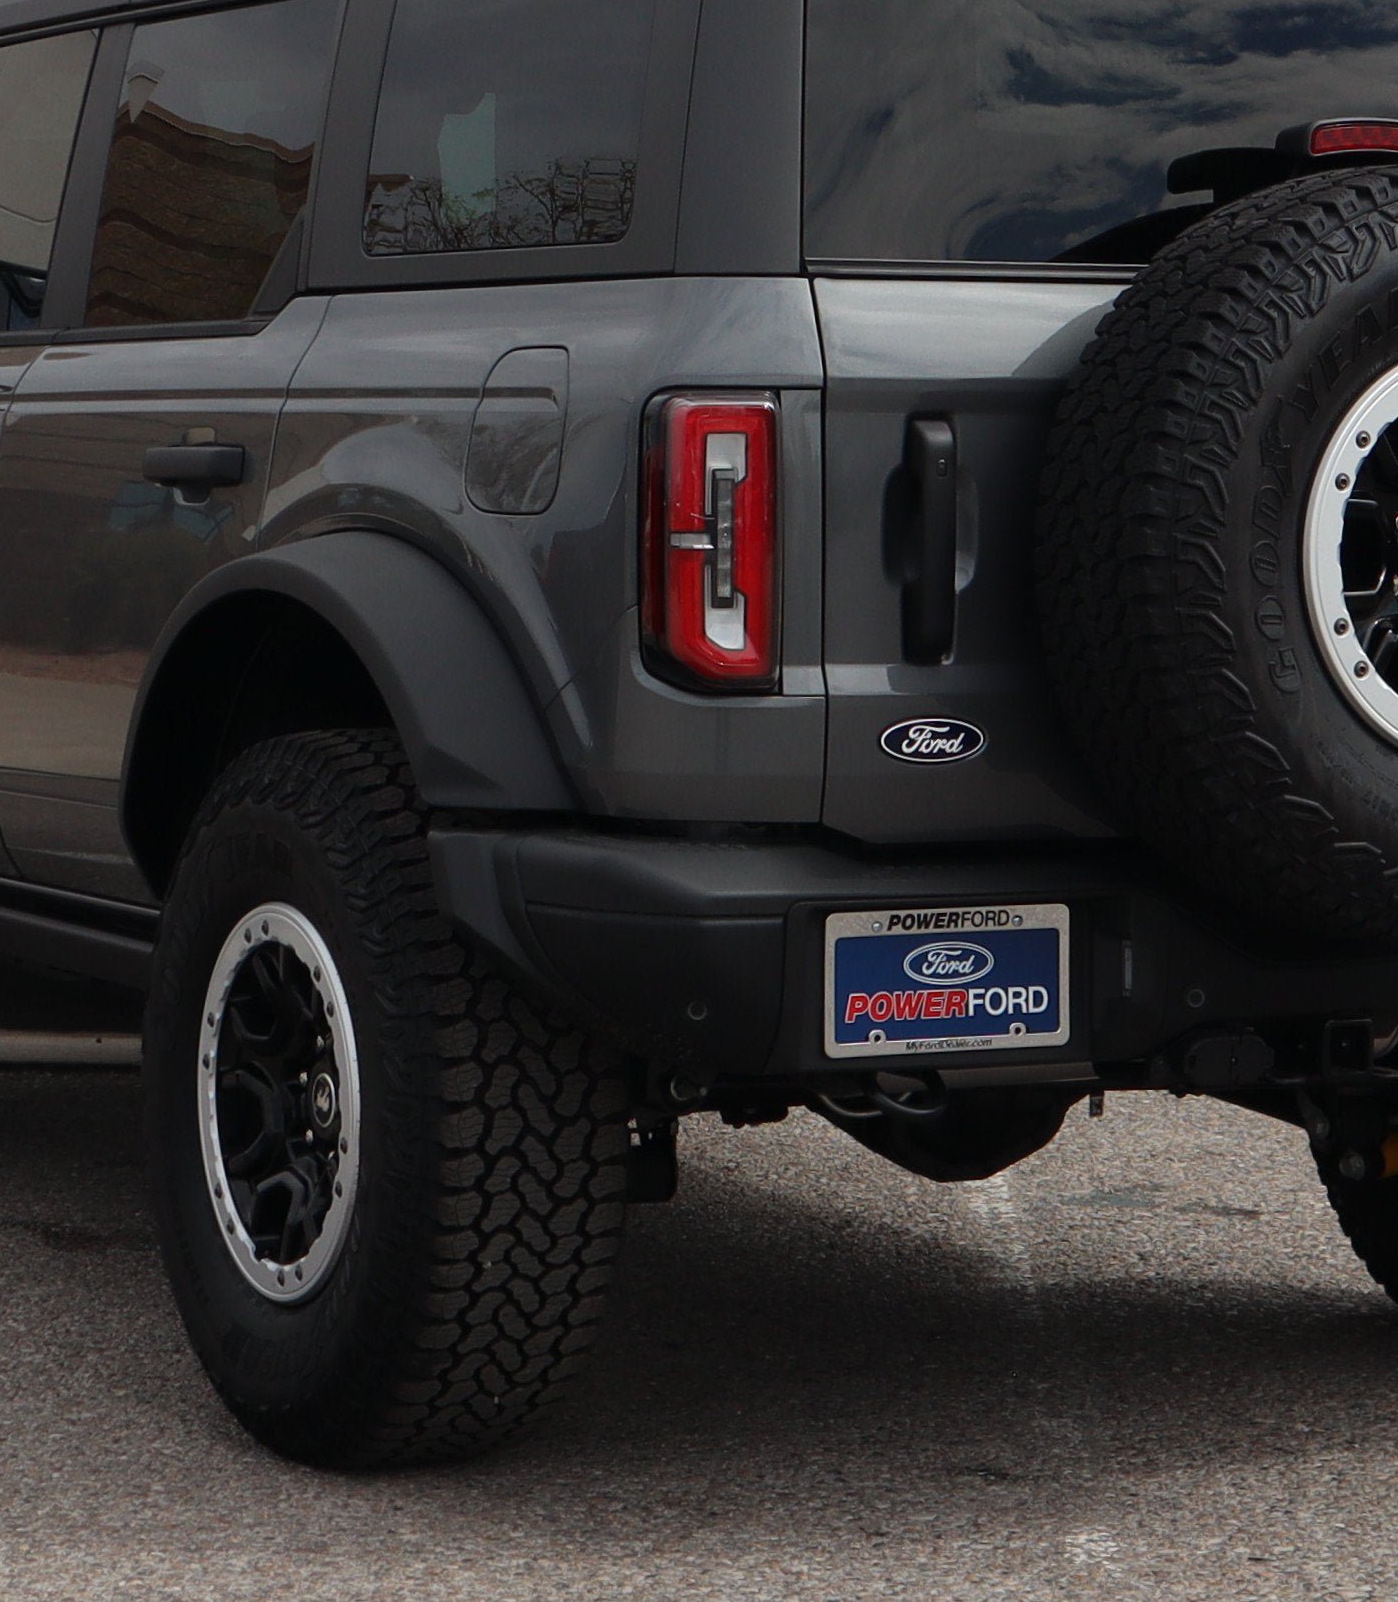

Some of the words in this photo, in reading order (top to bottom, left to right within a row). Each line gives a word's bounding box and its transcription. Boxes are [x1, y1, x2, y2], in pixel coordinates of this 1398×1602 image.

[901, 724, 965, 754] Ford
[887, 909, 1010, 932] POWERFORD
[922, 949, 975, 975] Ford
[845, 986, 1049, 1024] POWERFORD
